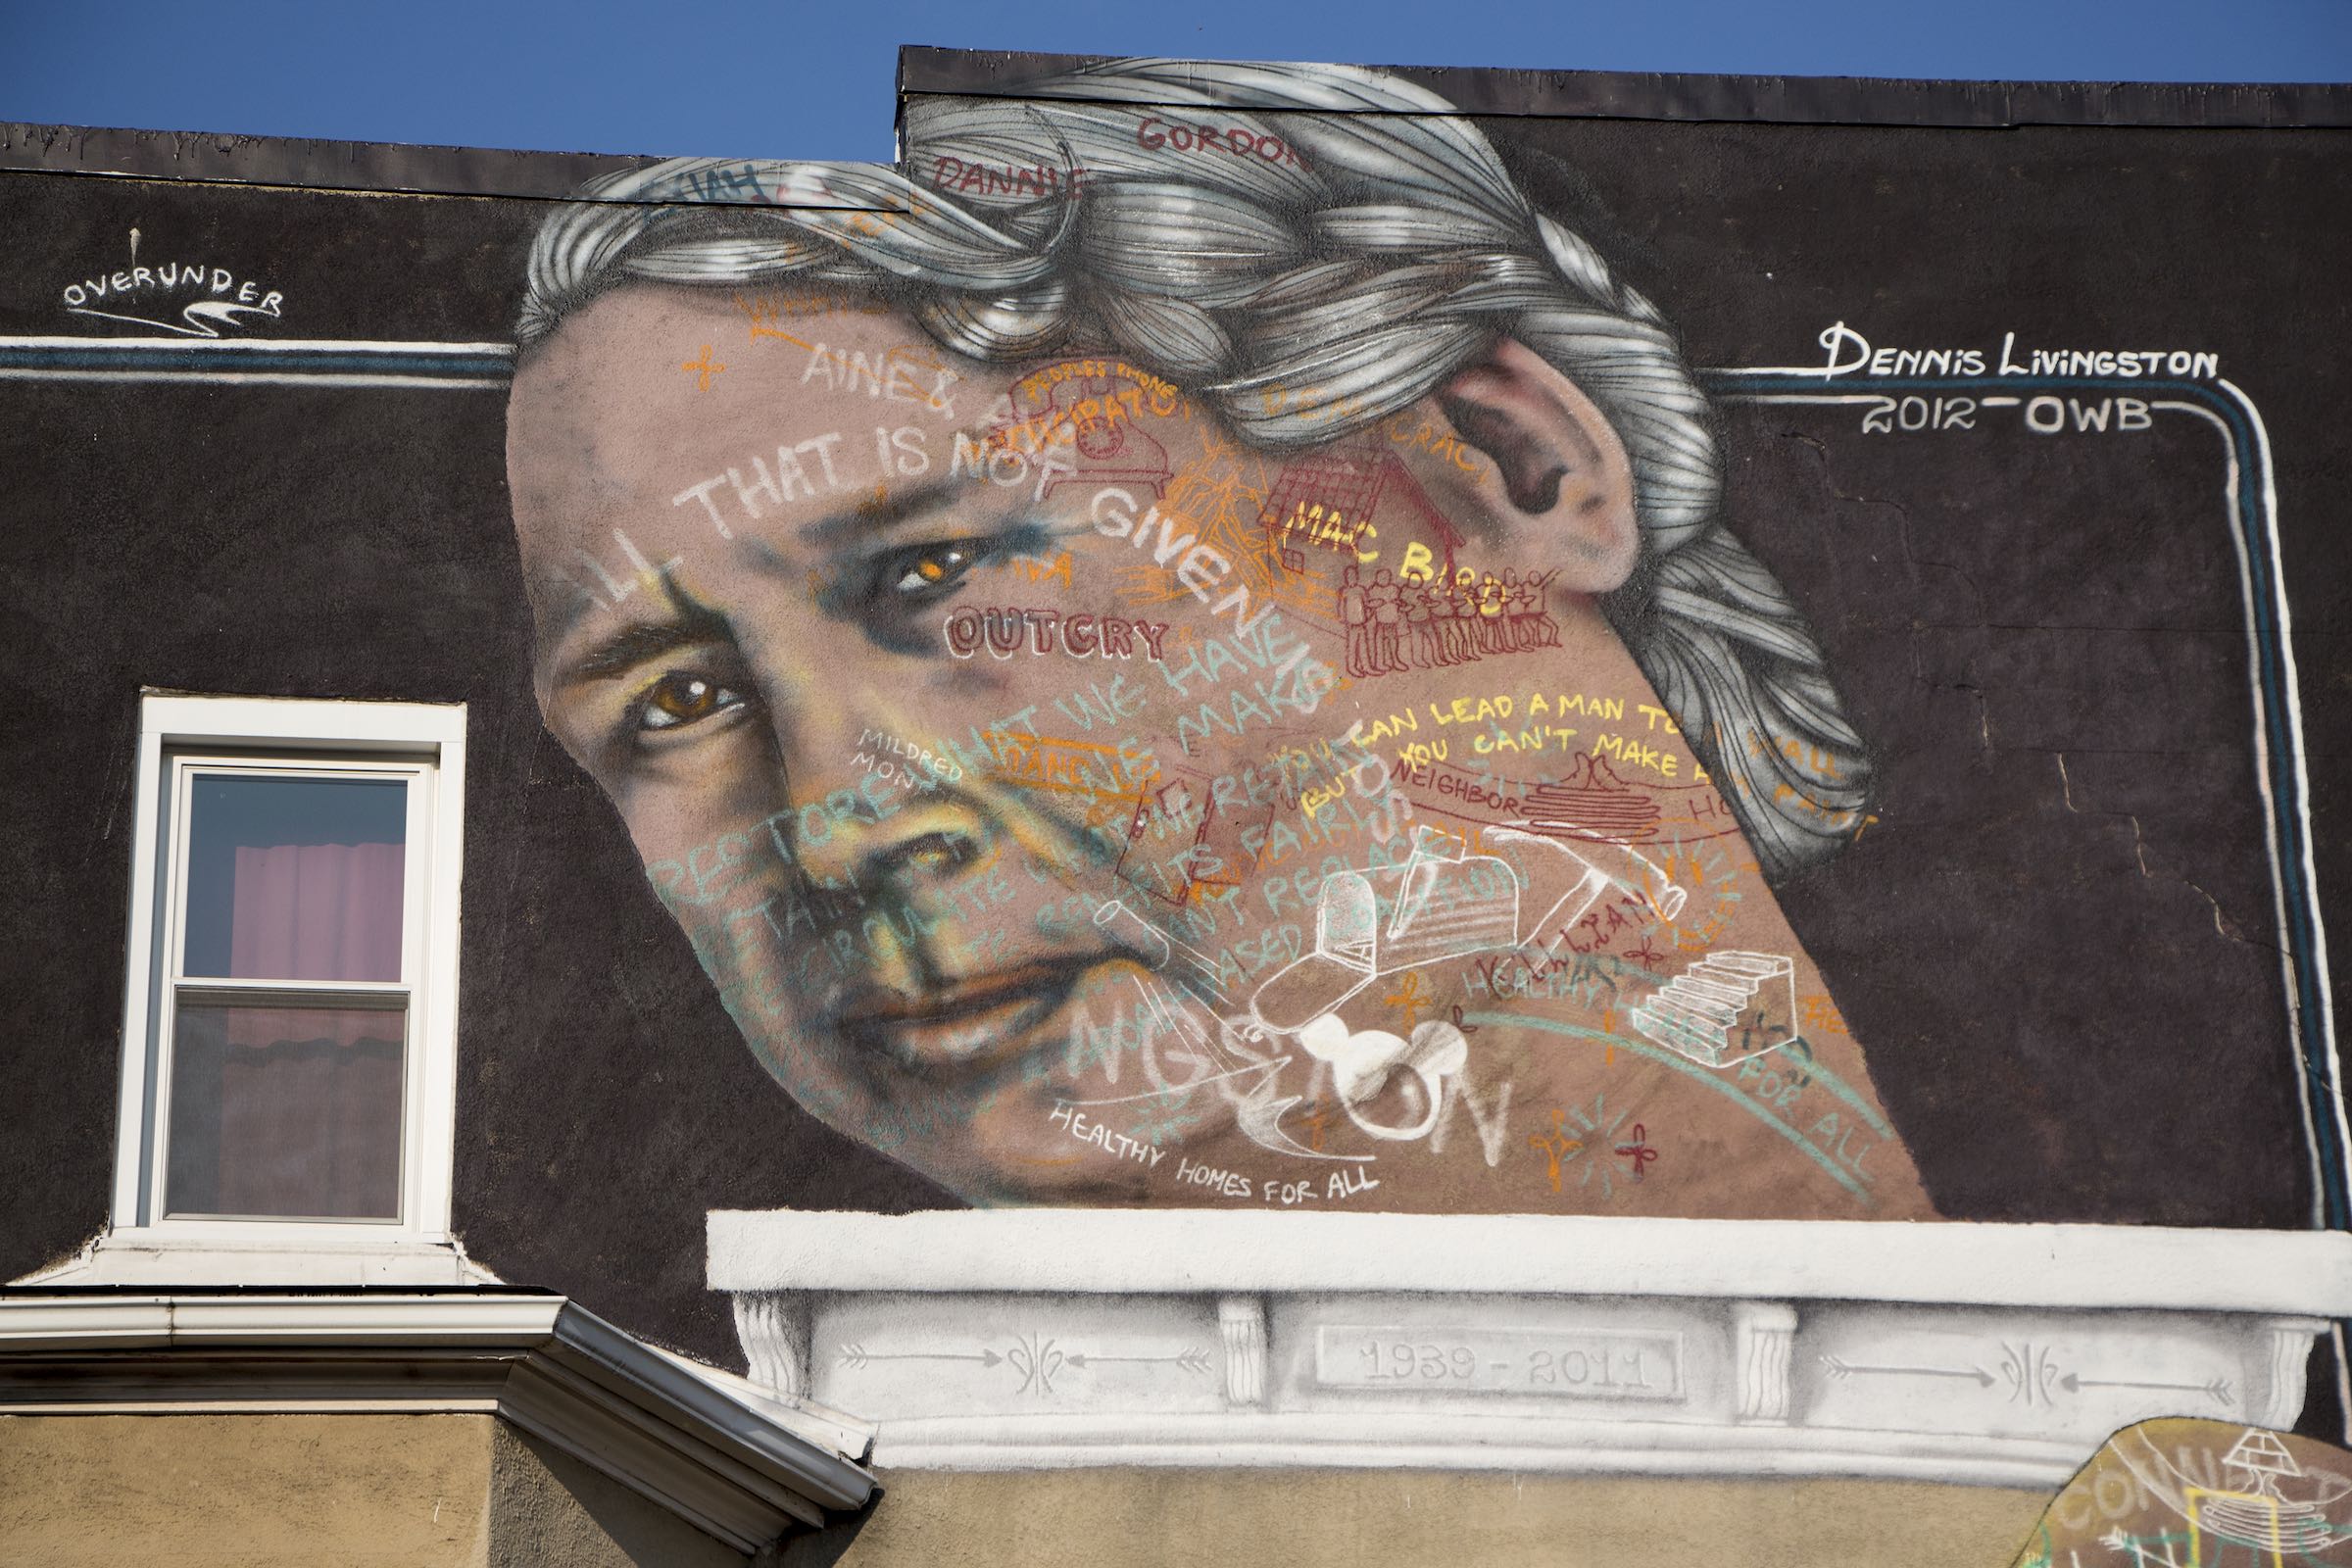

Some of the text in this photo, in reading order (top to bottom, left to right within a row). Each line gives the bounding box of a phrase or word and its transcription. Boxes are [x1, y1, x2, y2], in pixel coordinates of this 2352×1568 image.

[1136, 116, 1314, 173] GORDON
[64, 261, 284, 318] OVERUNDER
[1862, 396, 1976, 434] 2012
[2025, 396, 2152, 434] OWB
[673, 432, 841, 539] THAT
[874, 425, 929, 477] IS
[949, 431, 1077, 503] NOT
[1091, 488, 1275, 640] GIVEN
[944, 605, 1170, 662] OUTCRY
[1053, 673, 1147, 732] WE
[1156, 612, 1289, 697] HAVE
[1352, 708, 1418, 748] CAN
[1430, 694, 1514, 725] LEAD
[1529, 693, 1549, 717] A
[1559, 694, 1624, 720] MAN
[858, 728, 963, 782] MILDRED
[1300, 761, 1363, 820] BUT
[1397, 738, 1447, 772] YOU
[1474, 727, 1578, 755] CAN'T
[1592, 734, 1678, 778] MAKE
[1390, 758, 1519, 820] NEIGHBOR
[1048, 1102, 1380, 1205] HEALTHY HOMES FOR ALL
[1810, 1111, 1876, 1182] ALL
[1359, 1339, 1476, 1381] 1939
[1527, 1348, 1655, 1390] 2011
